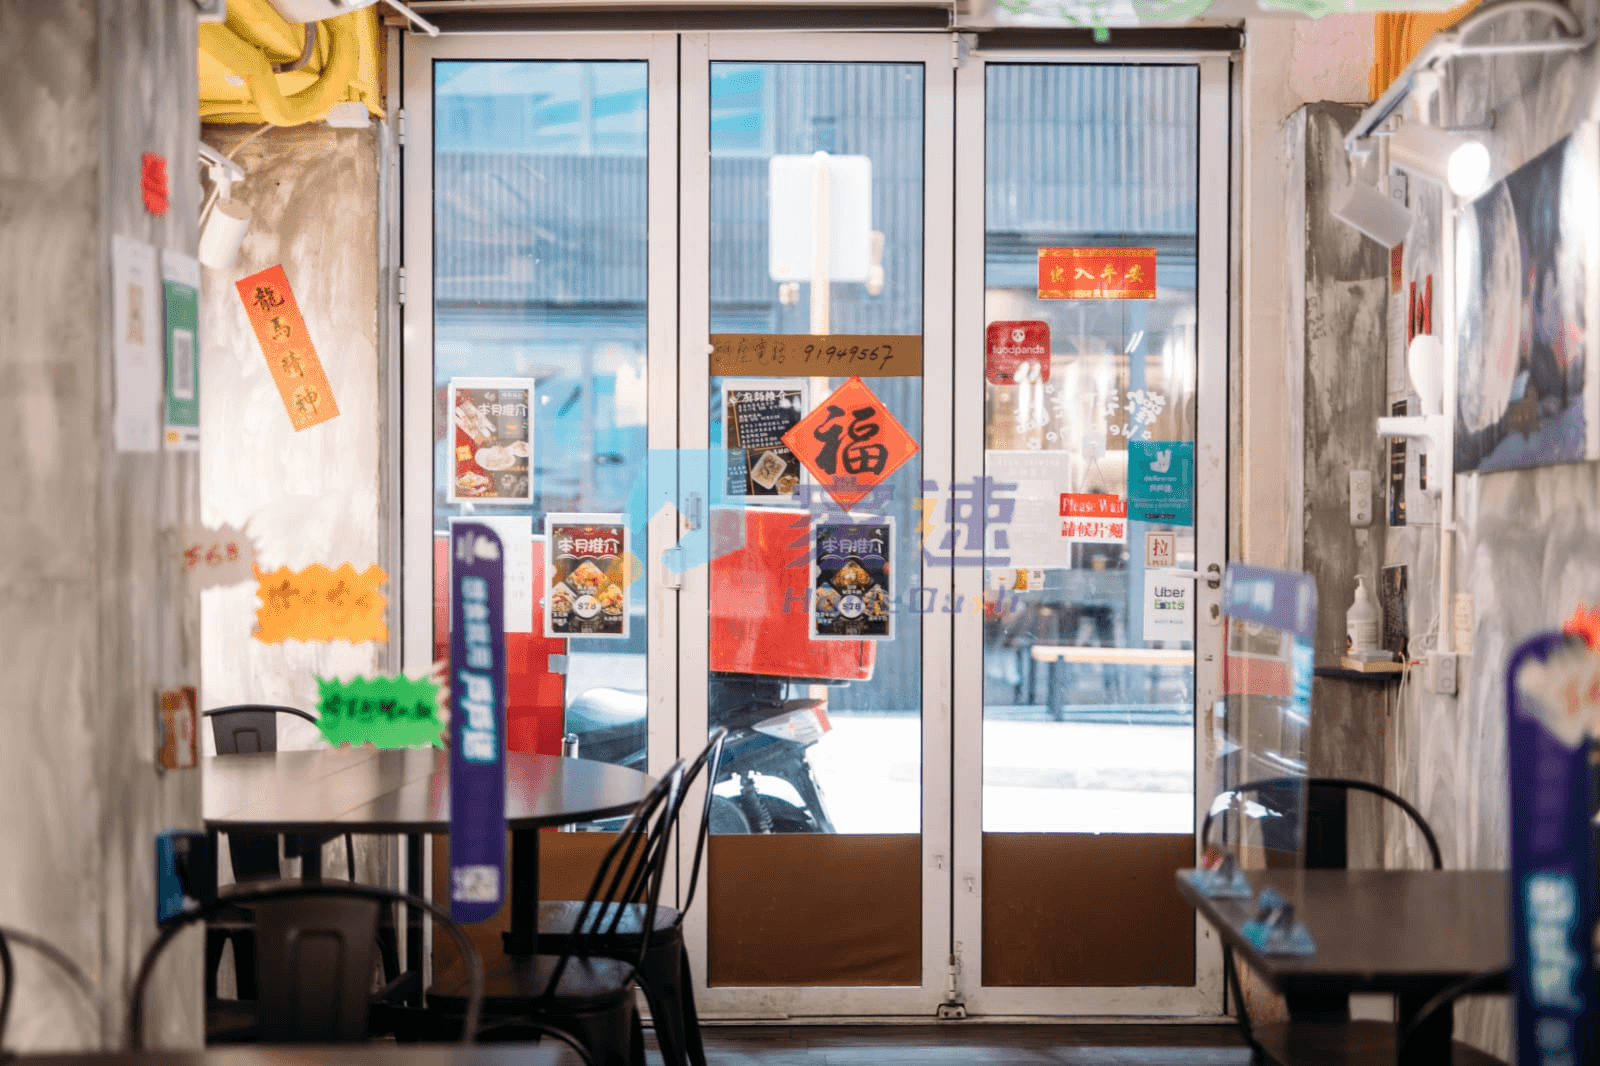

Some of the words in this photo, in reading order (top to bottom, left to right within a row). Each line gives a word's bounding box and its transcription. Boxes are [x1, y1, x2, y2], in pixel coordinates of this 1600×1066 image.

[1050, 264, 1144, 283] 出入平安
[252, 286, 320, 415] 龍馬精神
[804, 344, 894, 371] 91949567
[992, 344, 1045, 356] foodpanda
[478, 403, 528, 417] 本月推介
[813, 405, 889, 475] 福
[1063, 498, 1093, 513] Please
[558, 537, 620, 554] 本月推介
[822, 537, 884, 554] 本月推介
[1153, 538, 1168, 556] 拉
[1154, 586, 1184, 598] Uber
